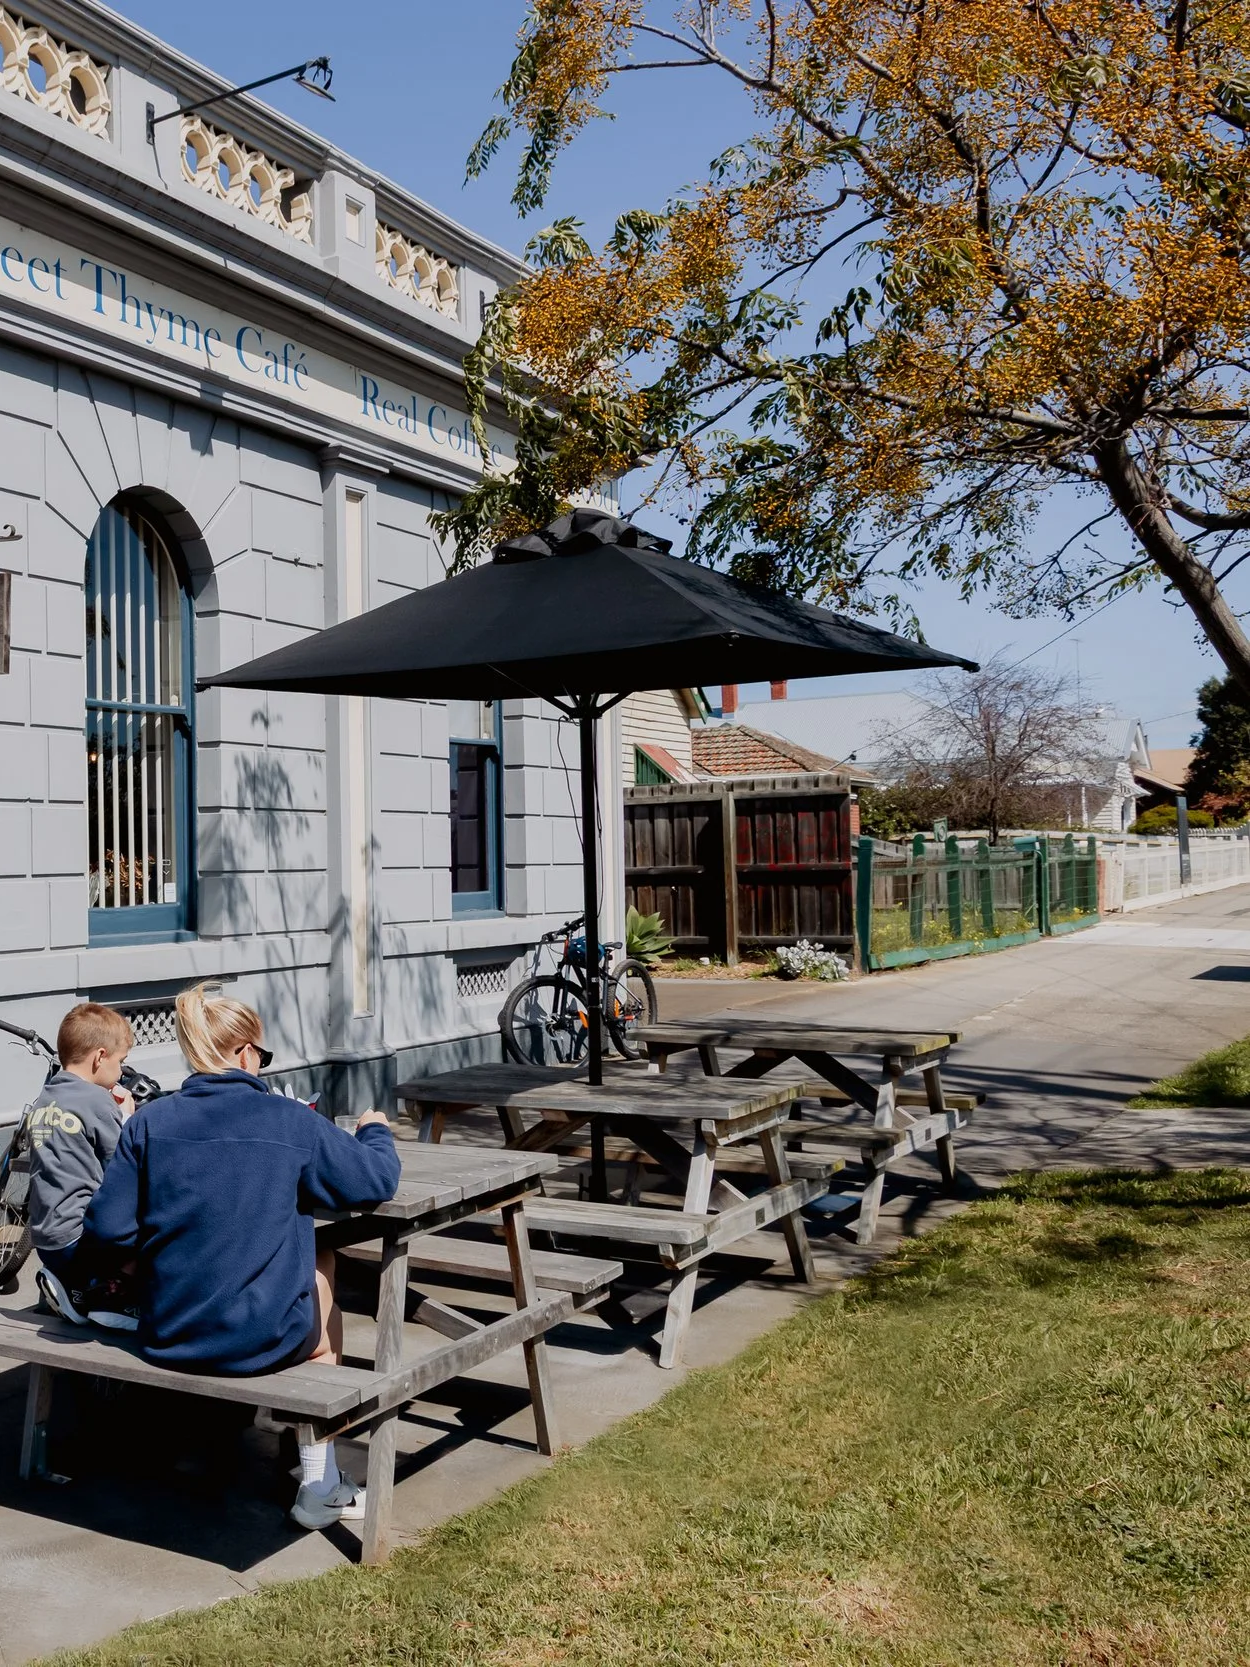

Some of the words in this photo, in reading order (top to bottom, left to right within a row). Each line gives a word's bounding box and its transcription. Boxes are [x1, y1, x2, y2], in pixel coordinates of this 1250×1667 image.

[80, 258, 223, 359] Thyme
[235, 326, 309, 392] Café
[360, 375, 418, 435] Real
[427, 404, 502, 468] Coffe
